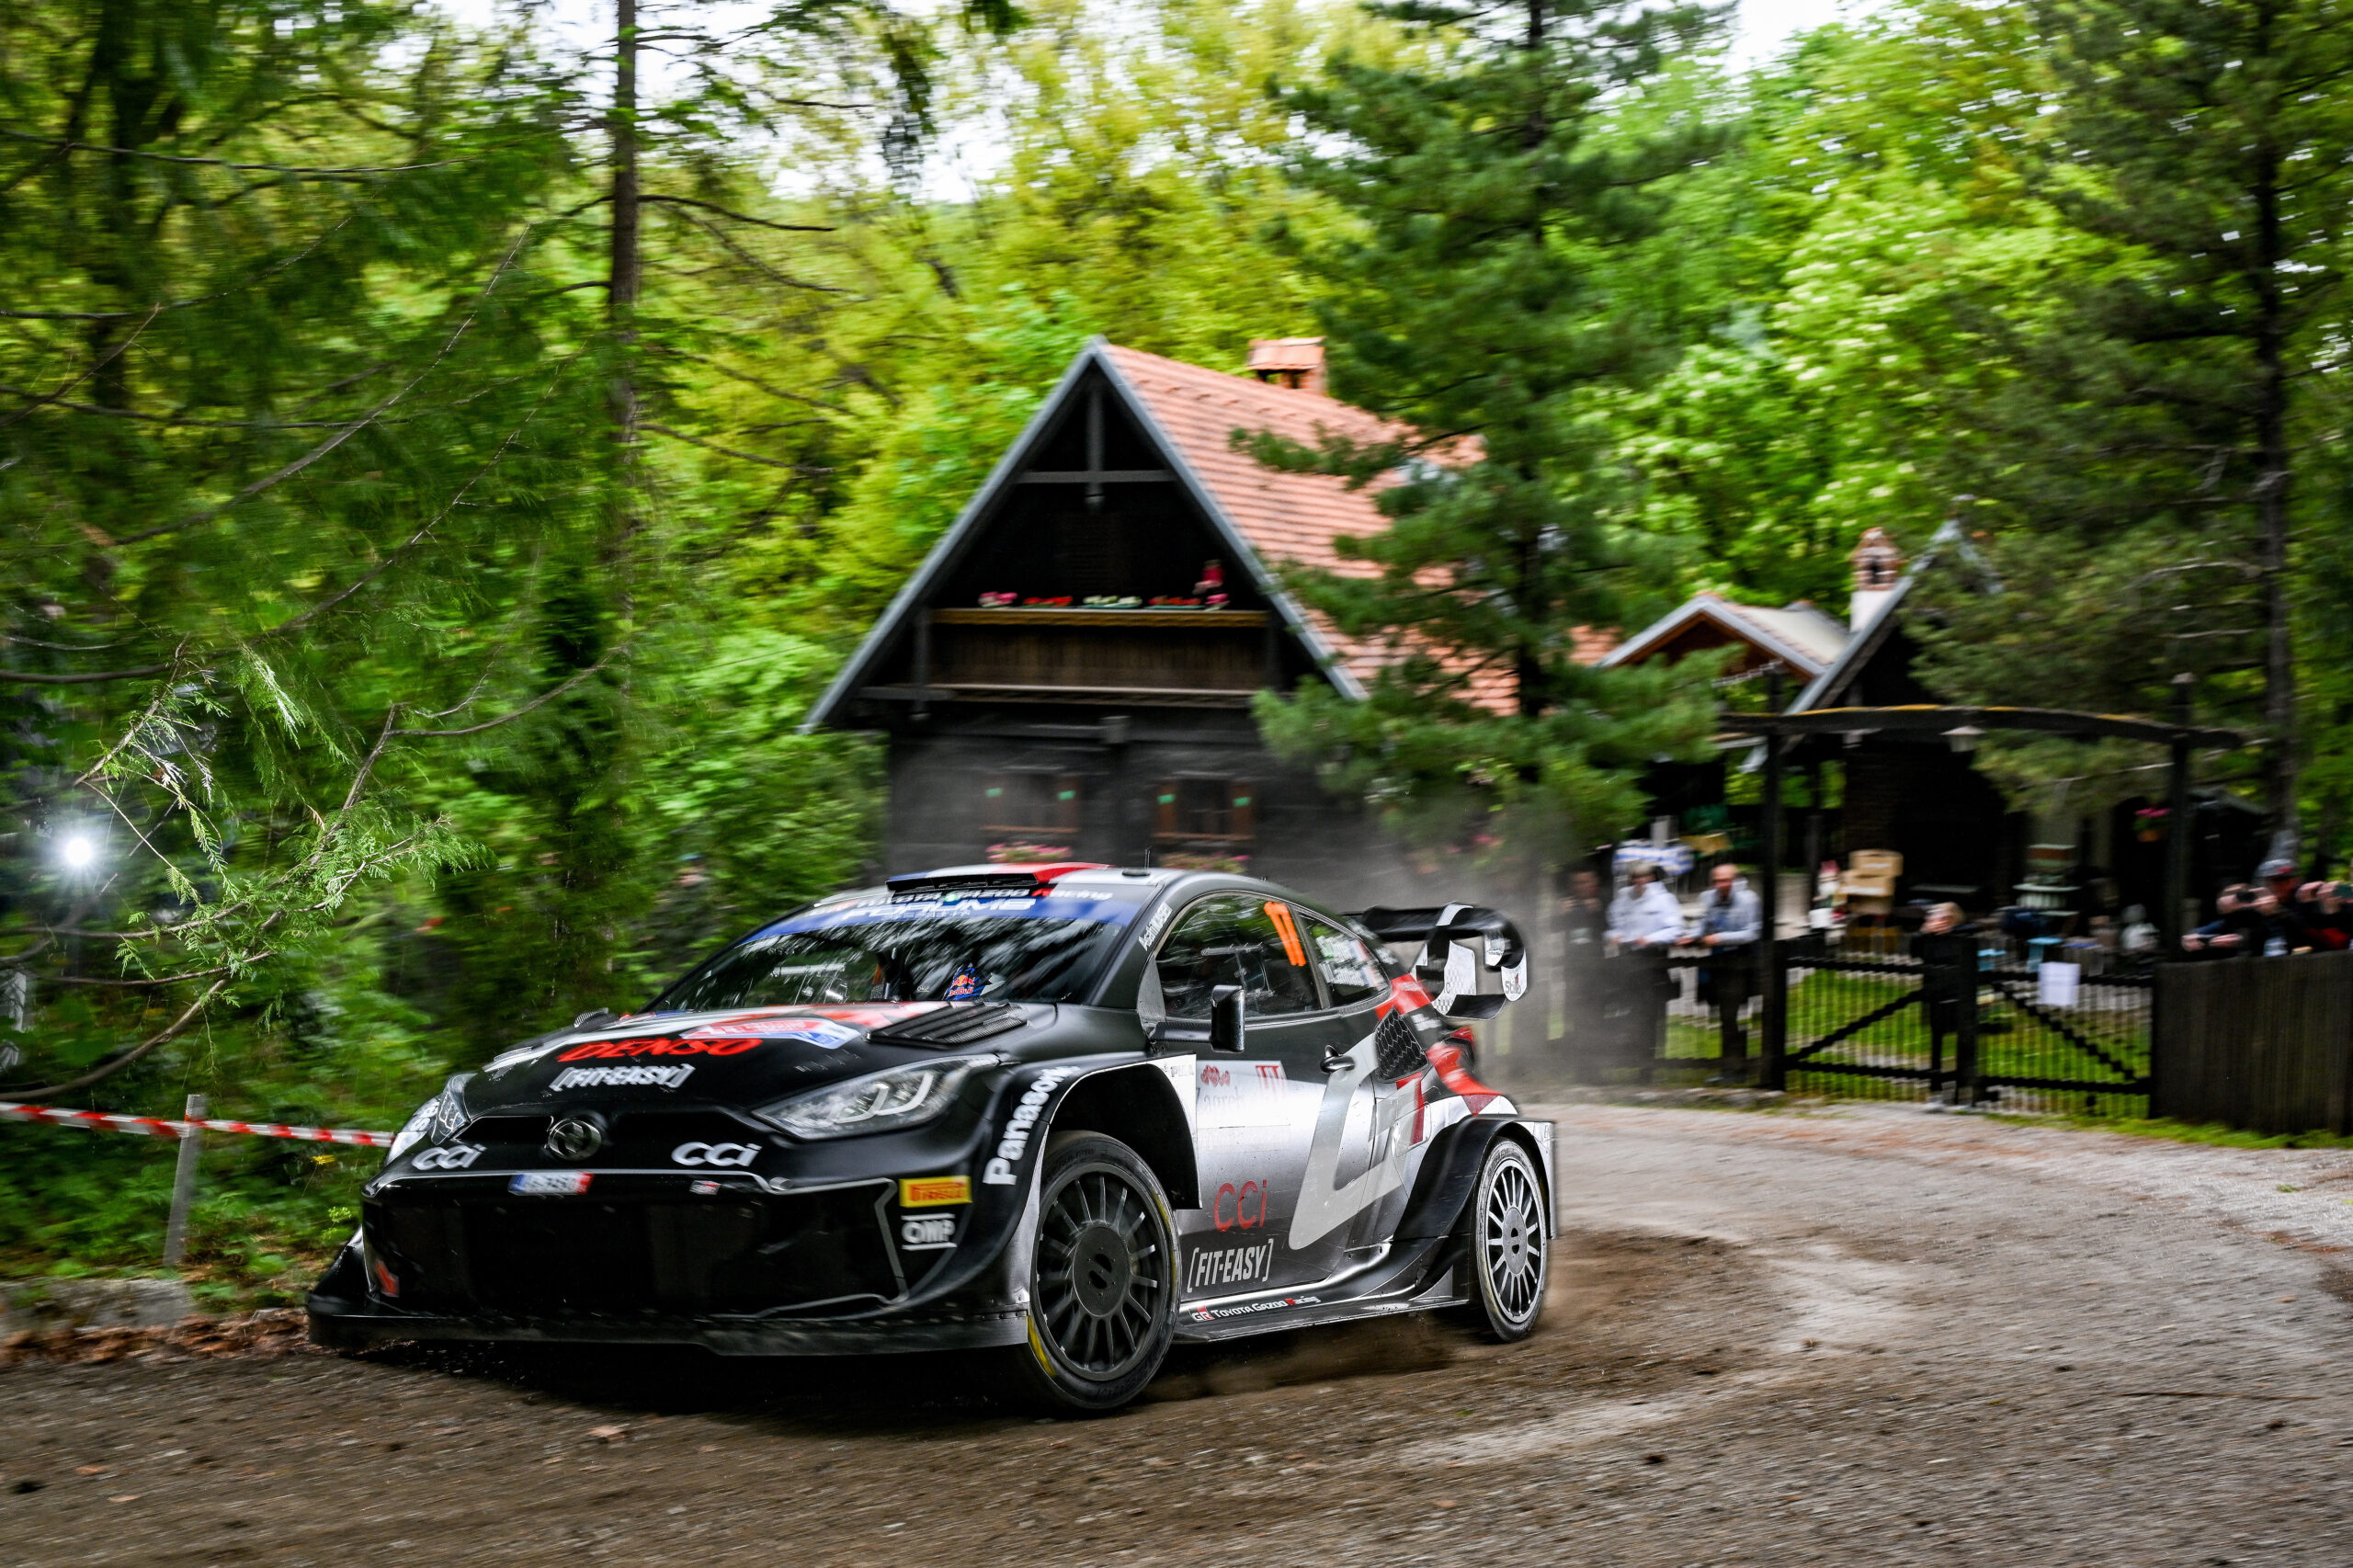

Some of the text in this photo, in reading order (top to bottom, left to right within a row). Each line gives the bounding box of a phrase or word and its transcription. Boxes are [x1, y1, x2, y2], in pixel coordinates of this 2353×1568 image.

[556, 1037, 764, 1062] DENSO
[901, 1218, 956, 1244] OMP
[1211, 1306, 1255, 1319] TOYOTA
